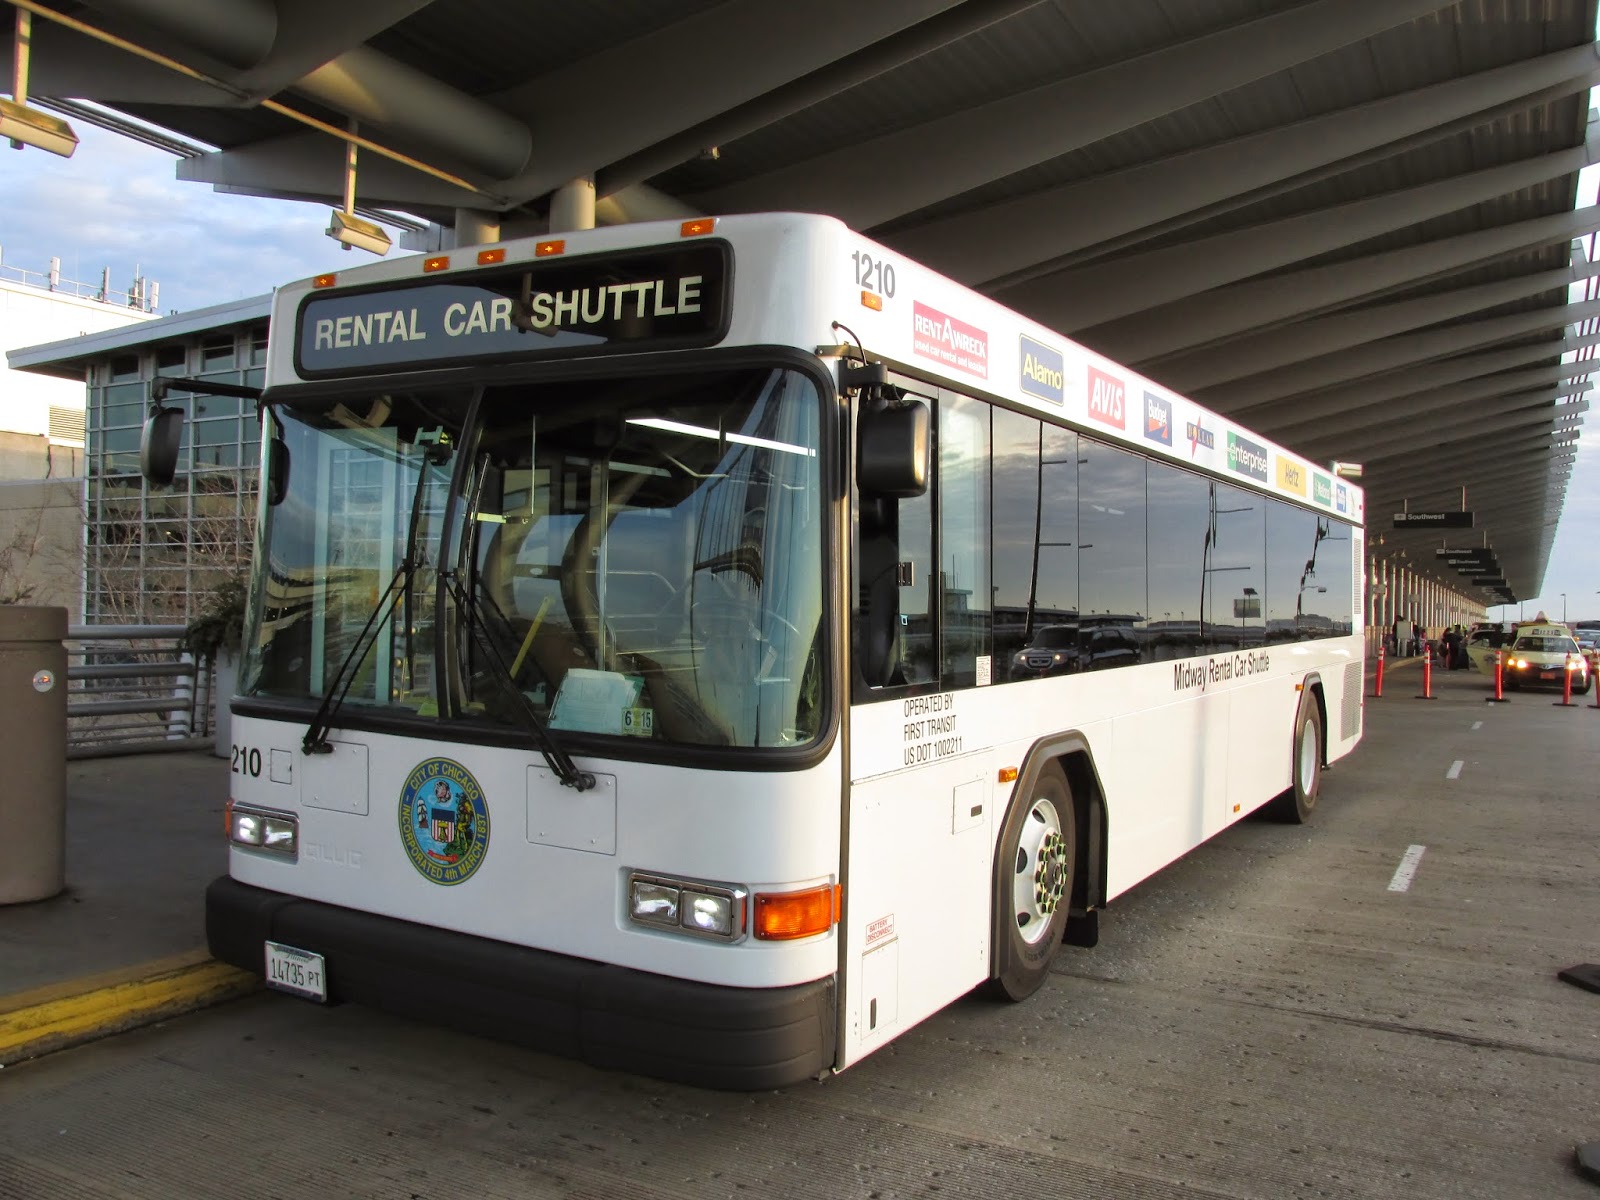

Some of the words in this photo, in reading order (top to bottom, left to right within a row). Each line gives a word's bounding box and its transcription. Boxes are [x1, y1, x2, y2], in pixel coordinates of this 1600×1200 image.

[851, 249, 896, 299] 1210
[314, 308, 427, 351] RENTAL
[443, 298, 513, 337] CAR
[530, 275, 703, 328] SHUTTLE
[1023, 353, 1062, 390] Alamo
[1090, 377, 1123, 421] AVIS
[1148, 398, 1167, 427] Budget
[1228, 442, 1267, 473] enterprise
[1285, 463, 1299, 487] Hertz
[1174, 662, 1207, 692] Midway
[1209, 655, 1233, 683] Rental
[1234, 654, 1247, 678] Car
[1247, 650, 1270, 675] Shuttle
[624, 710, 632, 726] 6
[641, 711, 651, 728] 15
[903, 694, 943, 718] OPERATED
[944, 693, 954, 710] BY
[903, 720, 925, 742] FIRST
[927, 714, 957, 736] TRANSIT
[231, 744, 262, 778] 210
[903, 746, 915, 765] US
[916, 743, 932, 762] DOT
[934, 735, 962, 757] 1002211
[410, 770, 427, 790] CITY
[427, 763, 440, 776] OF
[441, 763, 479, 801] CHICAGO
[401, 803, 443, 880] INCORPORATED
[444, 868, 459, 881] 4th
[457, 840, 484, 876] MARCH
[477, 813, 486, 839] 1837
[869, 918, 888, 933] BATTERY
[272, 957, 305, 986] 14735
[308, 970, 320, 987] PT
